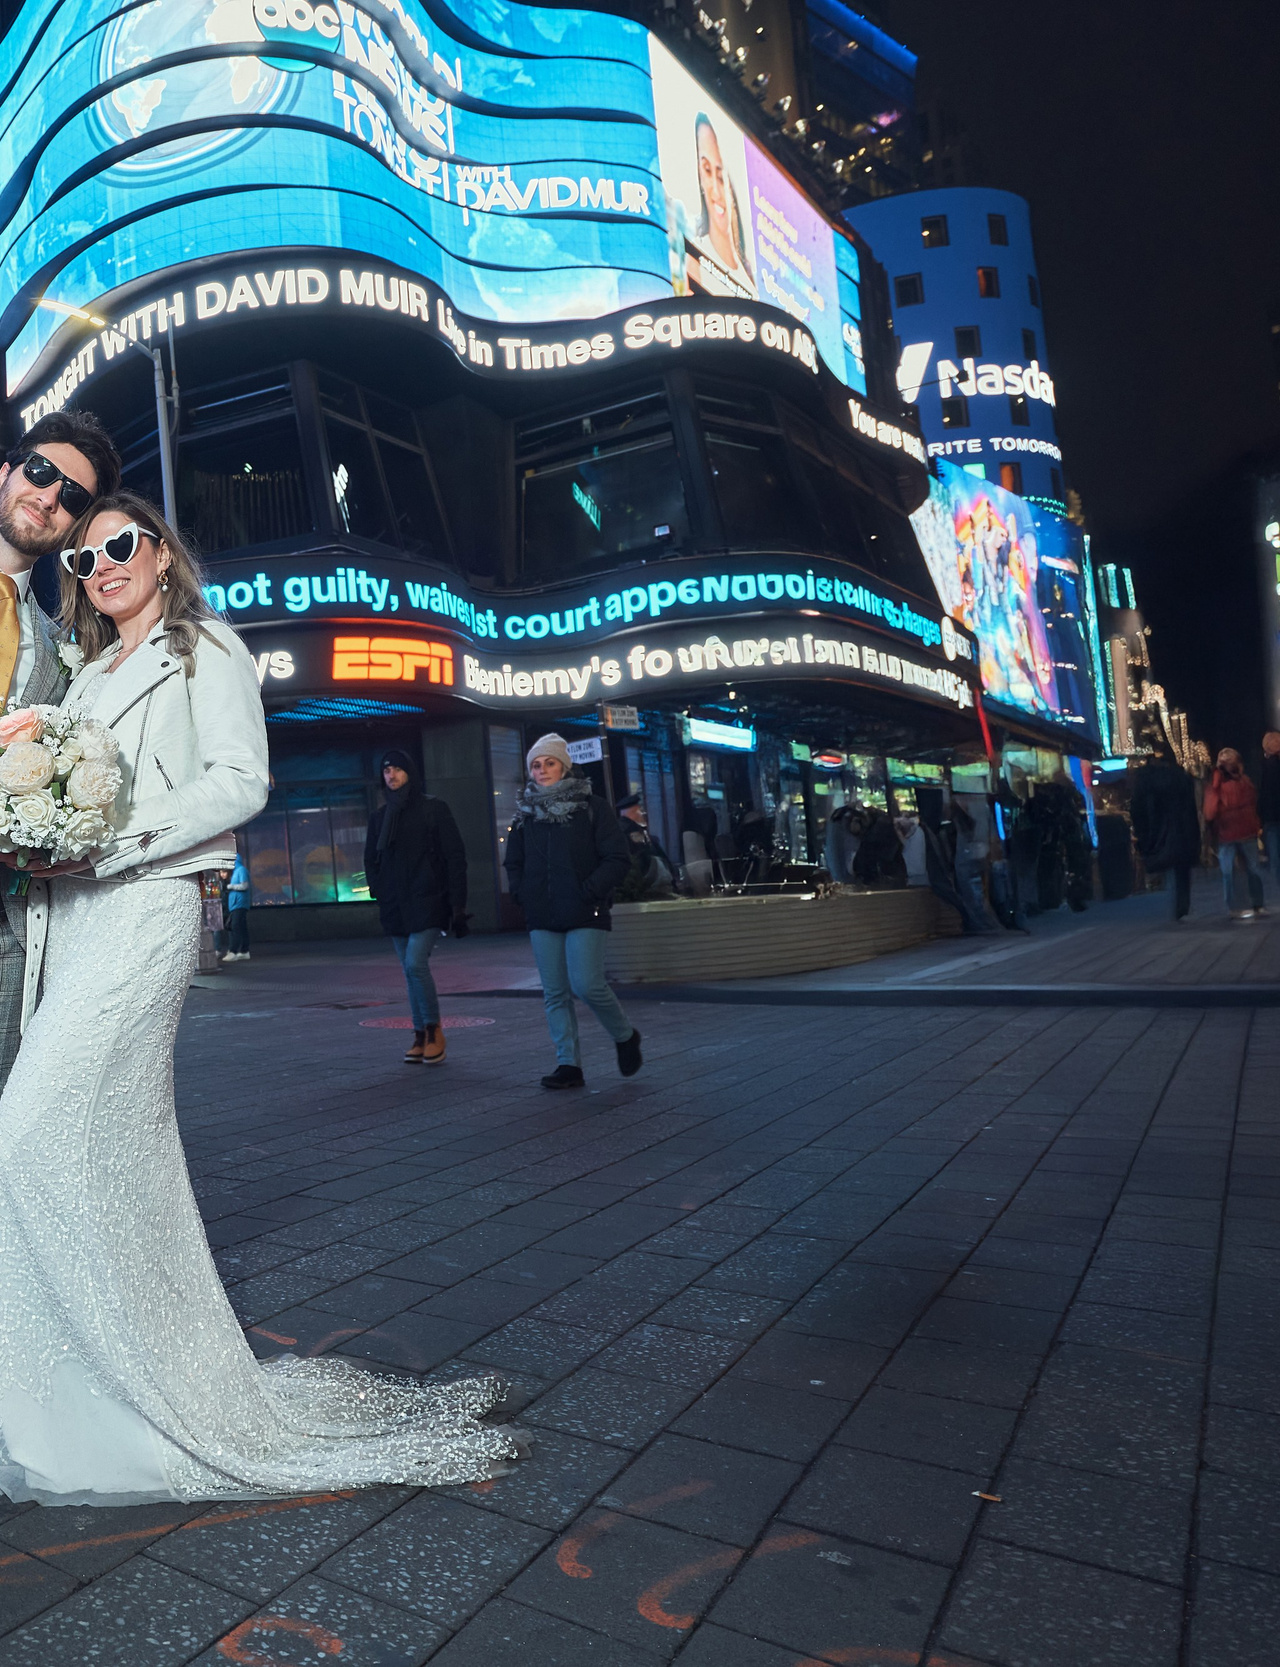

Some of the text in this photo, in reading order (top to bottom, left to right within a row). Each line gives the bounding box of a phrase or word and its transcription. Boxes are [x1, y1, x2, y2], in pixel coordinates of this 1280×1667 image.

[254, 0, 341, 38] abc
[455, 165, 511, 183] WITH
[20, 338, 98, 435] TONIGHT
[101, 291, 185, 361] WITH
[196, 268, 329, 320] DAVID
[340, 269, 430, 324] MUIR
[467, 330, 494, 367] in
[498, 331, 614, 373] Times
[623, 312, 756, 350] Square
[760, 320, 791, 353] on
[848, 398, 876, 438] You
[202, 572, 273, 613] not
[283, 566, 400, 614] guilty,
[405, 581, 471, 633] waives
[503, 596, 600, 640] court
[332, 636, 454, 686] ESPN
